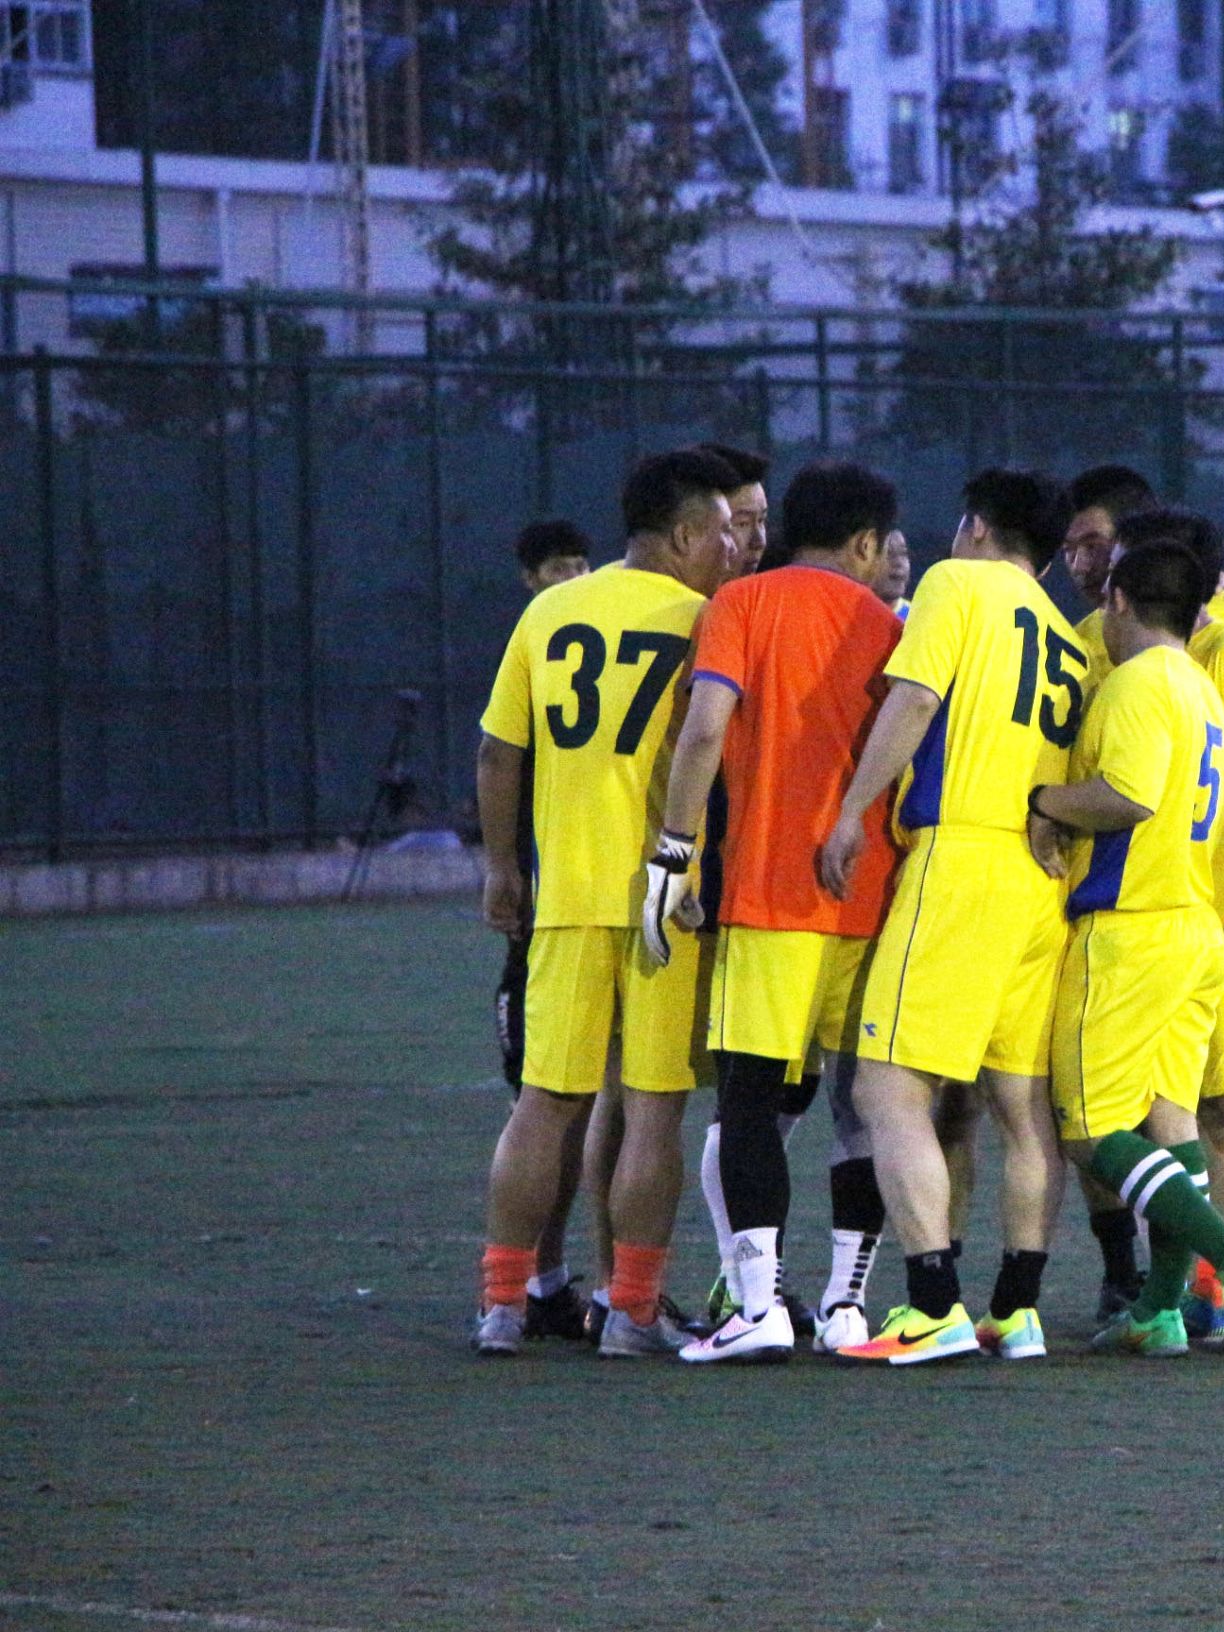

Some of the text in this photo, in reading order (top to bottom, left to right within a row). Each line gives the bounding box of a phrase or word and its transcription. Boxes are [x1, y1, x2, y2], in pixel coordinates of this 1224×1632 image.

[546, 623, 690, 755] 37
[1011, 606, 1088, 748] 15
[1190, 721, 1224, 842] 5
